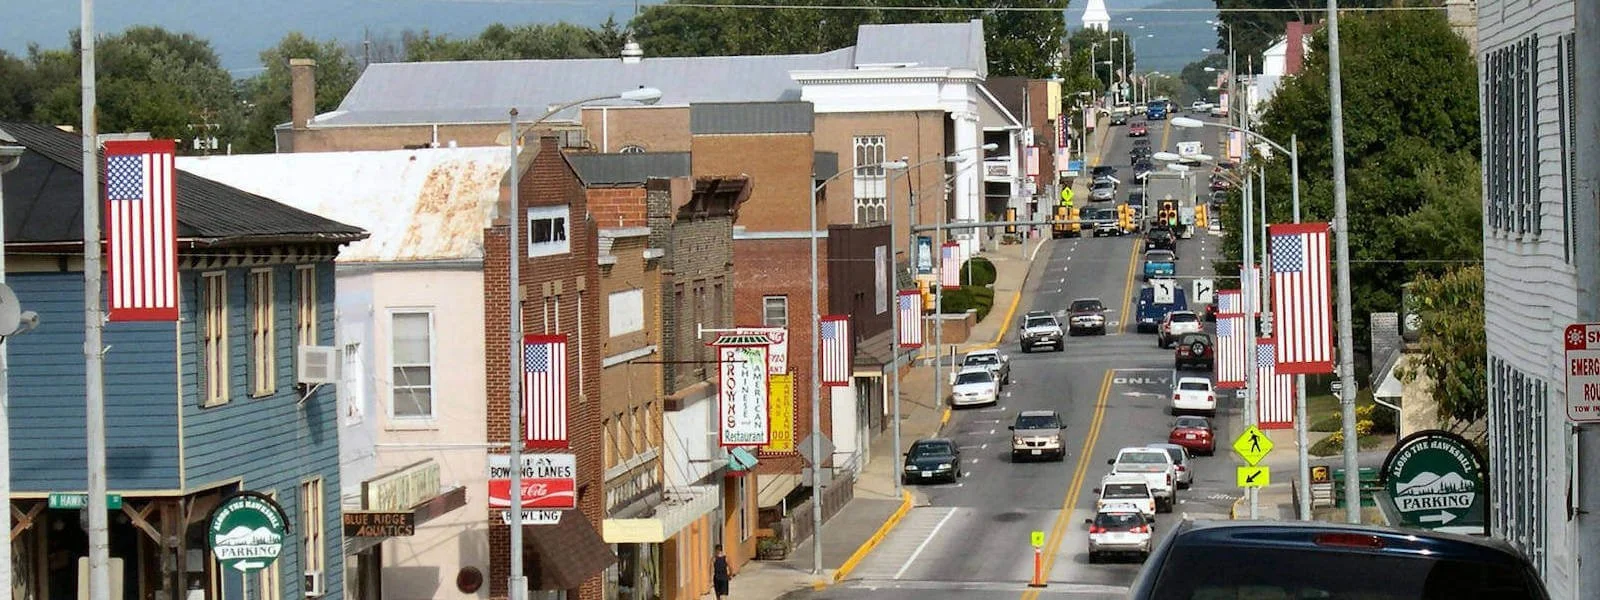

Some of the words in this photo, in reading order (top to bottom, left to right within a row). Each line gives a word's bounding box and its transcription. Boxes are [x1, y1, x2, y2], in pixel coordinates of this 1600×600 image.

[726, 351, 736, 429] BROWNS
[741, 362, 749, 418] CHINESE
[753, 364, 762, 428] AMERICAN
[1393, 450, 1412, 478] ALONG
[1411, 442, 1429, 454] THE
[1430, 441, 1472, 473] HAWKSBILL
[491, 467, 534, 478] BOWNG
[538, 466, 571, 478] LANES
[50, 495, 57, 506] N
[228, 501, 245, 512] THE
[1403, 494, 1470, 510] PARKING
[345, 514, 369, 525] BLUE
[374, 513, 406, 525] RIDGE
[506, 510, 558, 521] BWLING
[357, 524, 413, 537] AQUATICS
[221, 546, 277, 557] PARKING
